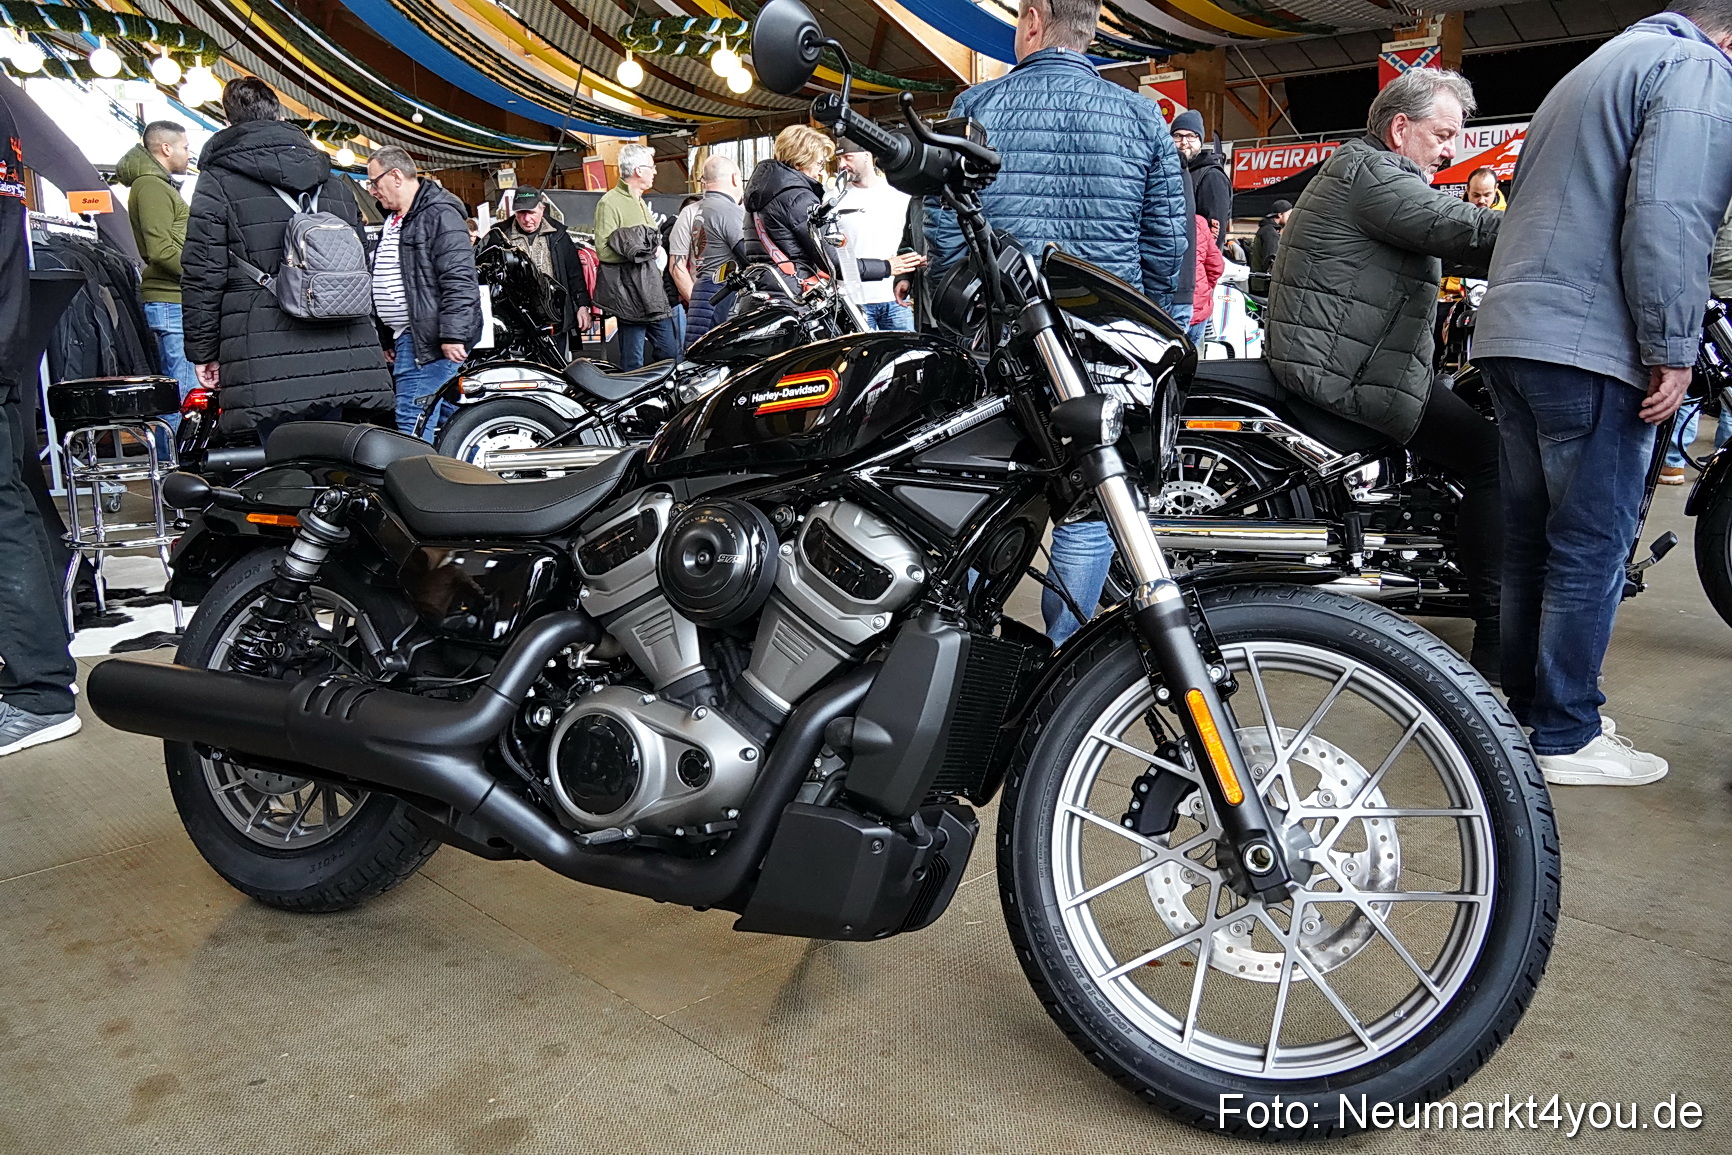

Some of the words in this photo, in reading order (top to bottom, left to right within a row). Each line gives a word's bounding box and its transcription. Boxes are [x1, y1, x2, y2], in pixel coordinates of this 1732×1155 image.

[751, 384, 826, 403] Harley-Davidson
[721, 522, 737, 539] MAX
[1347, 629, 1518, 805] HARLEY-DAVIDSON
